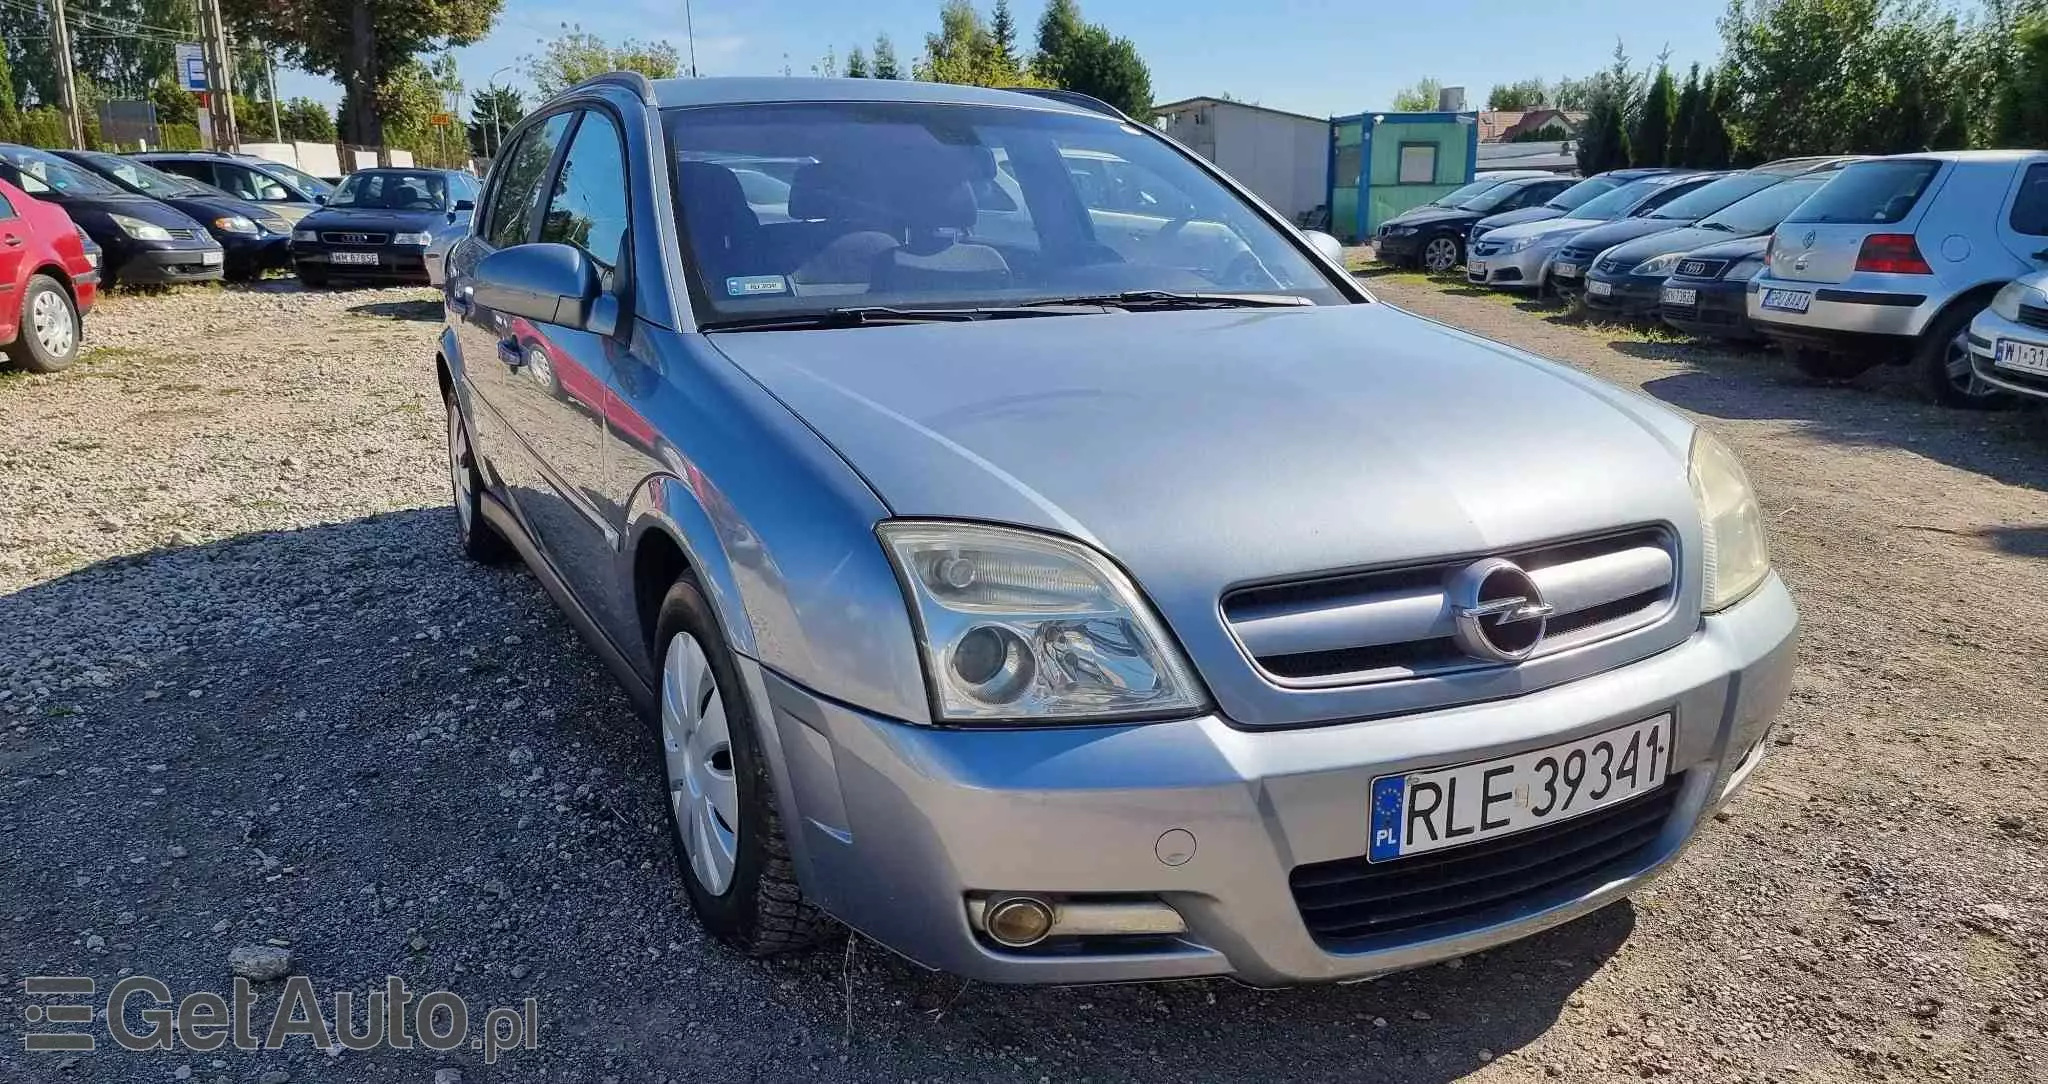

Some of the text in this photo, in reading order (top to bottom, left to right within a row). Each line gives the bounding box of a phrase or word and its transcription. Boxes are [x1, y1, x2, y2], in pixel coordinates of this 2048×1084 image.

[2029, 347, 2048, 368] 31
[1405, 725, 1661, 846] RLE 39341
[1376, 830, 1398, 847] PL
